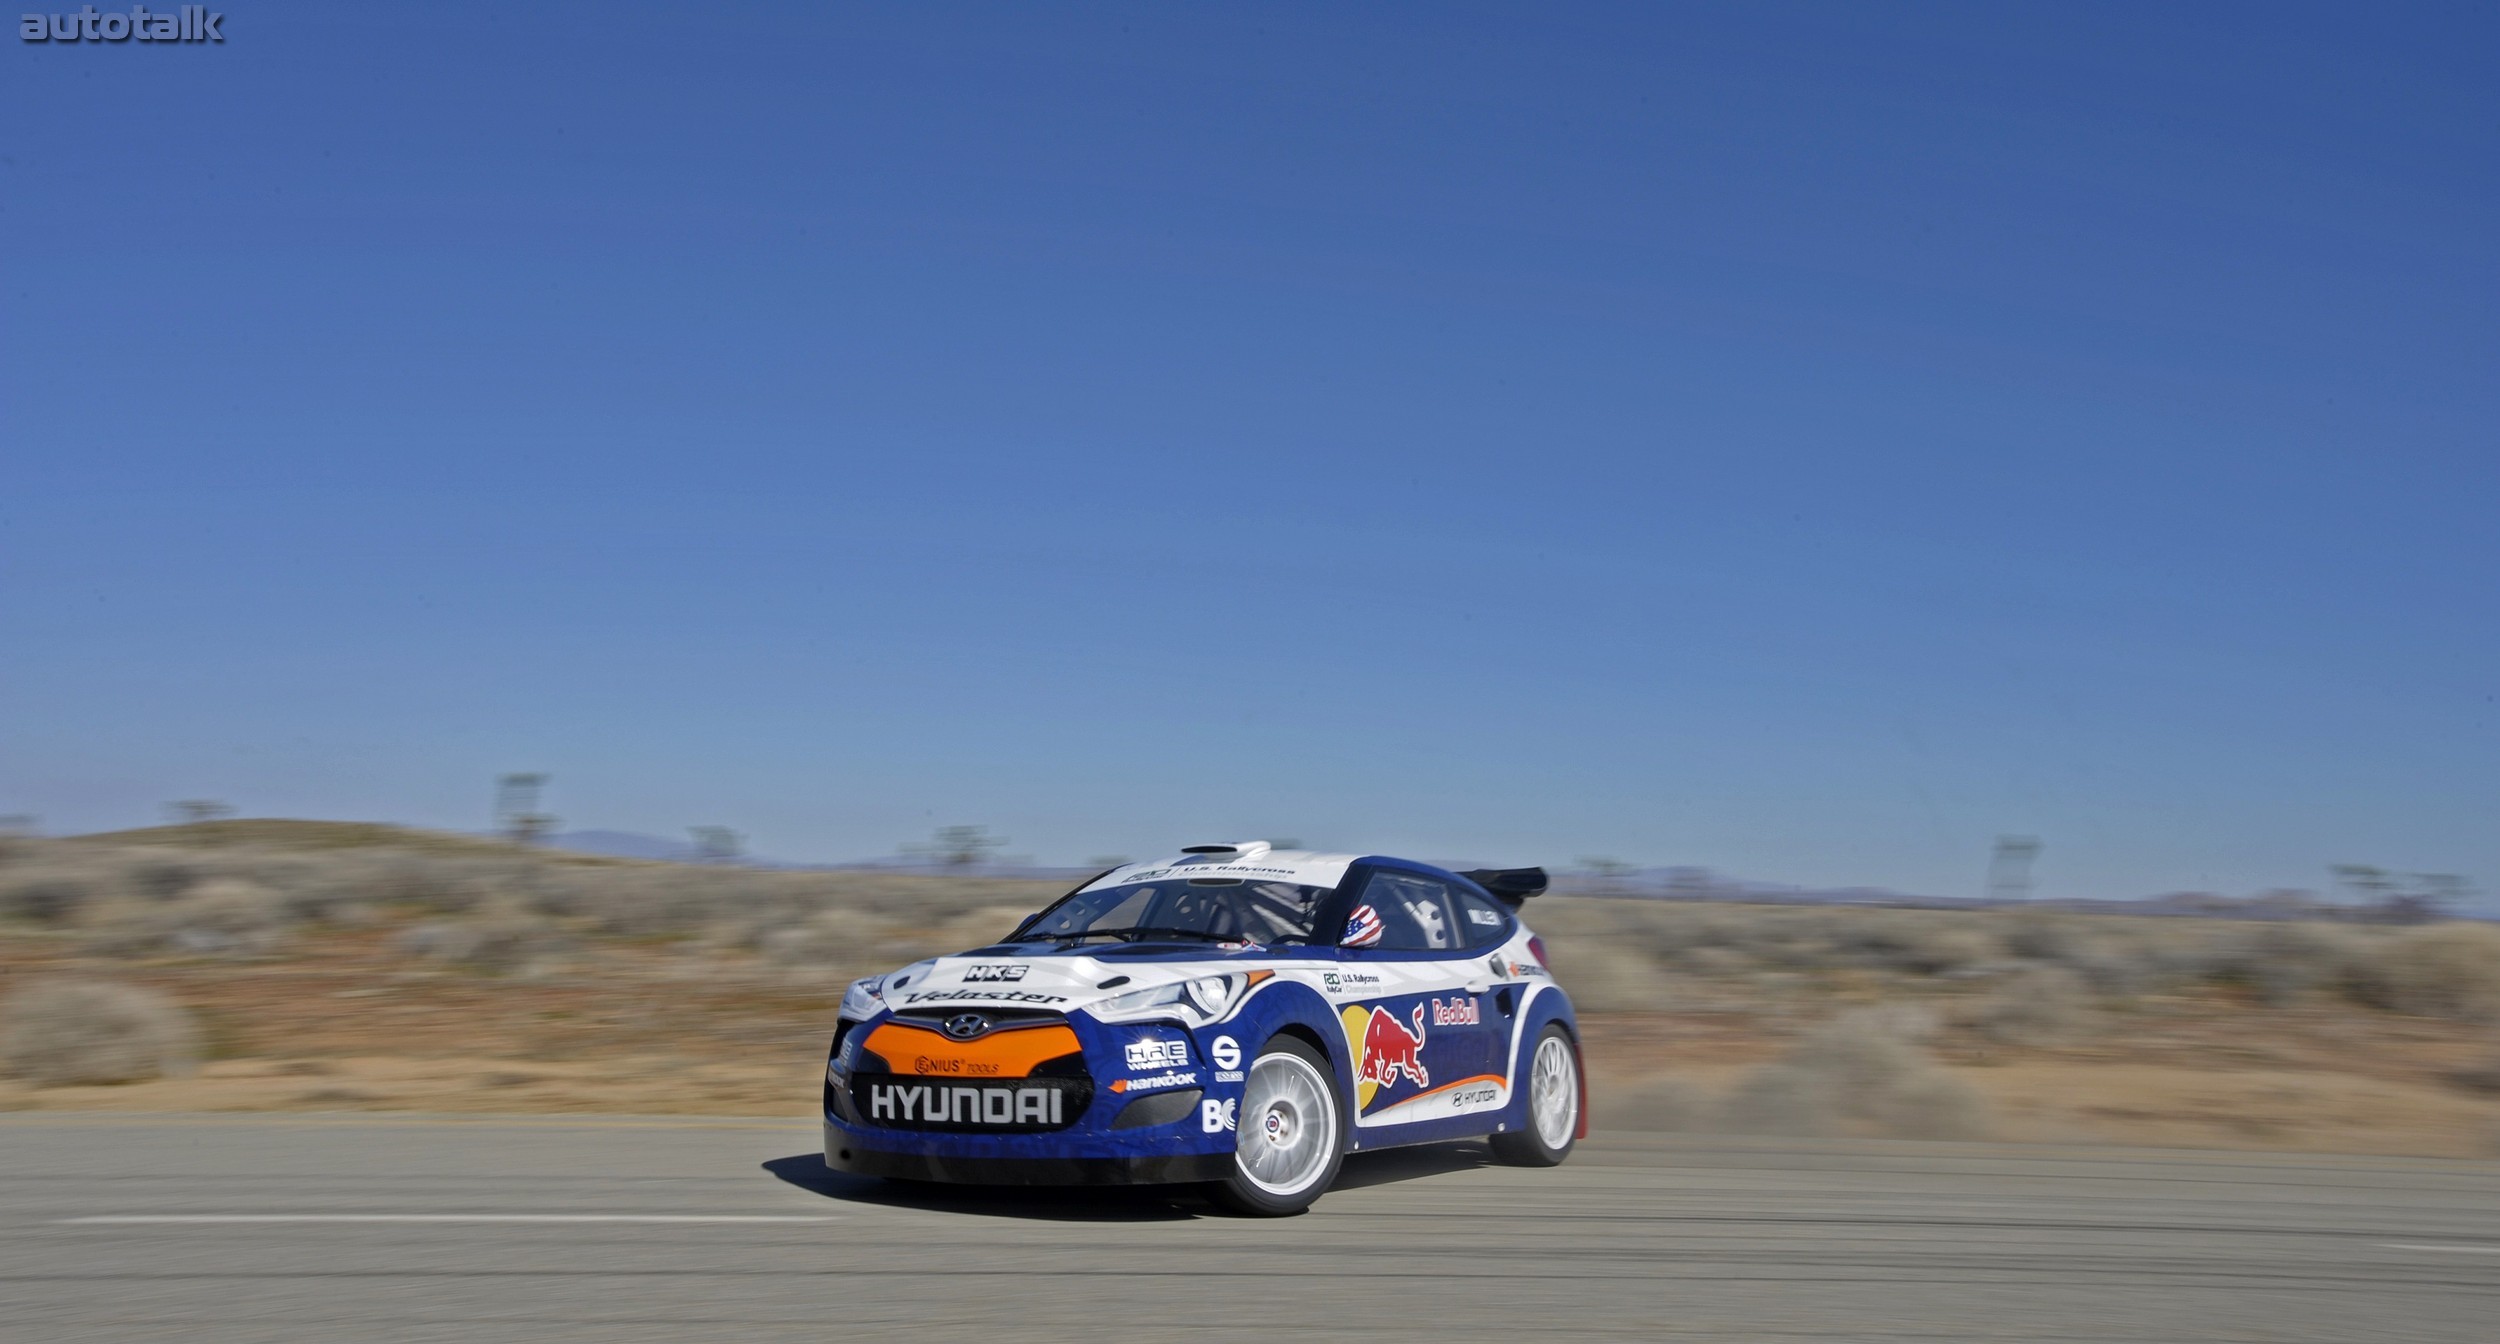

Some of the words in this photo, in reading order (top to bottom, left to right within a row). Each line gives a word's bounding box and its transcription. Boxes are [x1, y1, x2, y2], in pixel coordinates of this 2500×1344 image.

[1216, 865, 1297, 876] Rallycross
[962, 965, 1030, 982] HKS
[904, 989, 1068, 1004] Veloster
[1124, 1040, 1188, 1063] HRE
[967, 1063, 1000, 1074] TOOLS
[1126, 1060, 1189, 1071] WHEELS
[871, 1084, 1063, 1125] HYUNDAI
[1464, 1089, 1497, 1105] HYUNDAI
